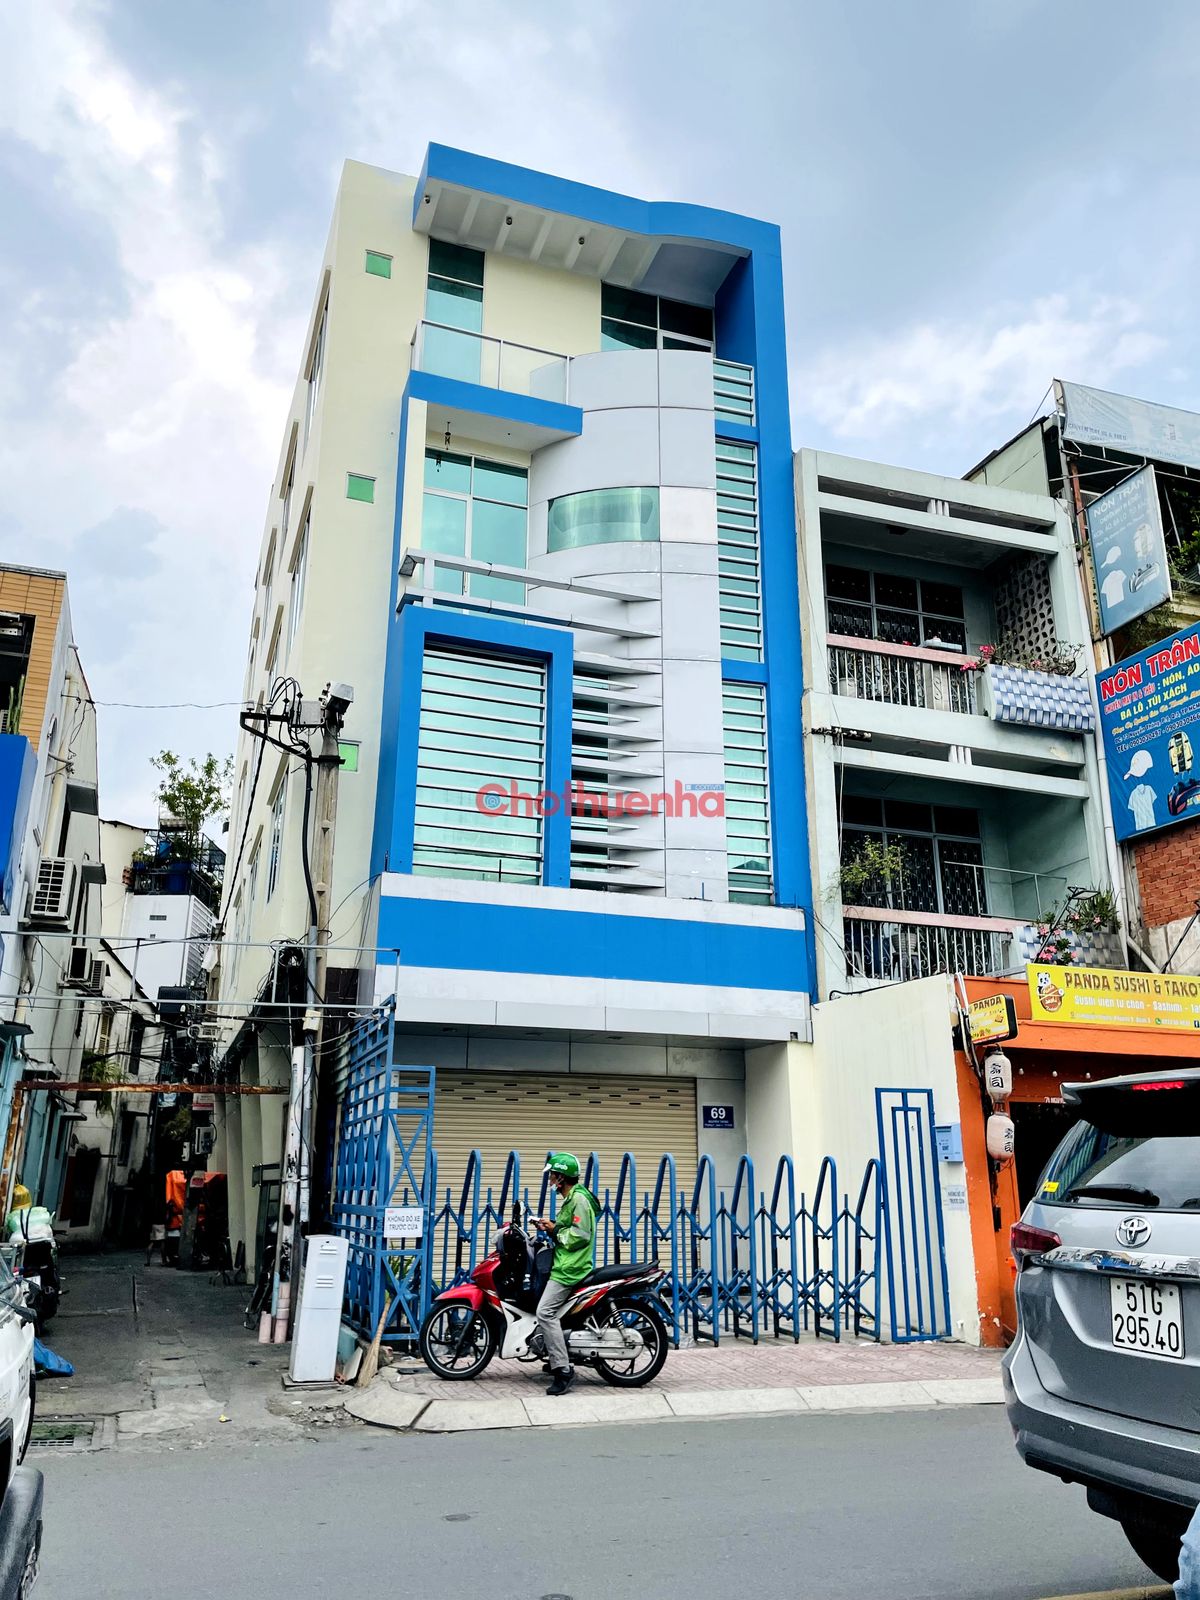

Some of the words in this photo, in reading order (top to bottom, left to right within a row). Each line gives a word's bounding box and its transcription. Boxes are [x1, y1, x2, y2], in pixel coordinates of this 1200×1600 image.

[1100, 667, 1143, 701] NÓN
[1120, 708, 1132, 720] BA
[1133, 701, 1144, 715] LÔ
[1163, 682, 1188, 702] XÁCH
[1064, 972, 1111, 991] PANDA
[1114, 976, 1150, 994] SUSHI
[1153, 979, 1161, 994] &
[1164, 980, 1200, 998] TAKO
[973, 996, 1002, 1011] PANDA
[710, 1107, 726, 1119] 69
[1125, 1282, 1163, 1316] 51G
[1113, 1313, 1180, 1353] 295.40
